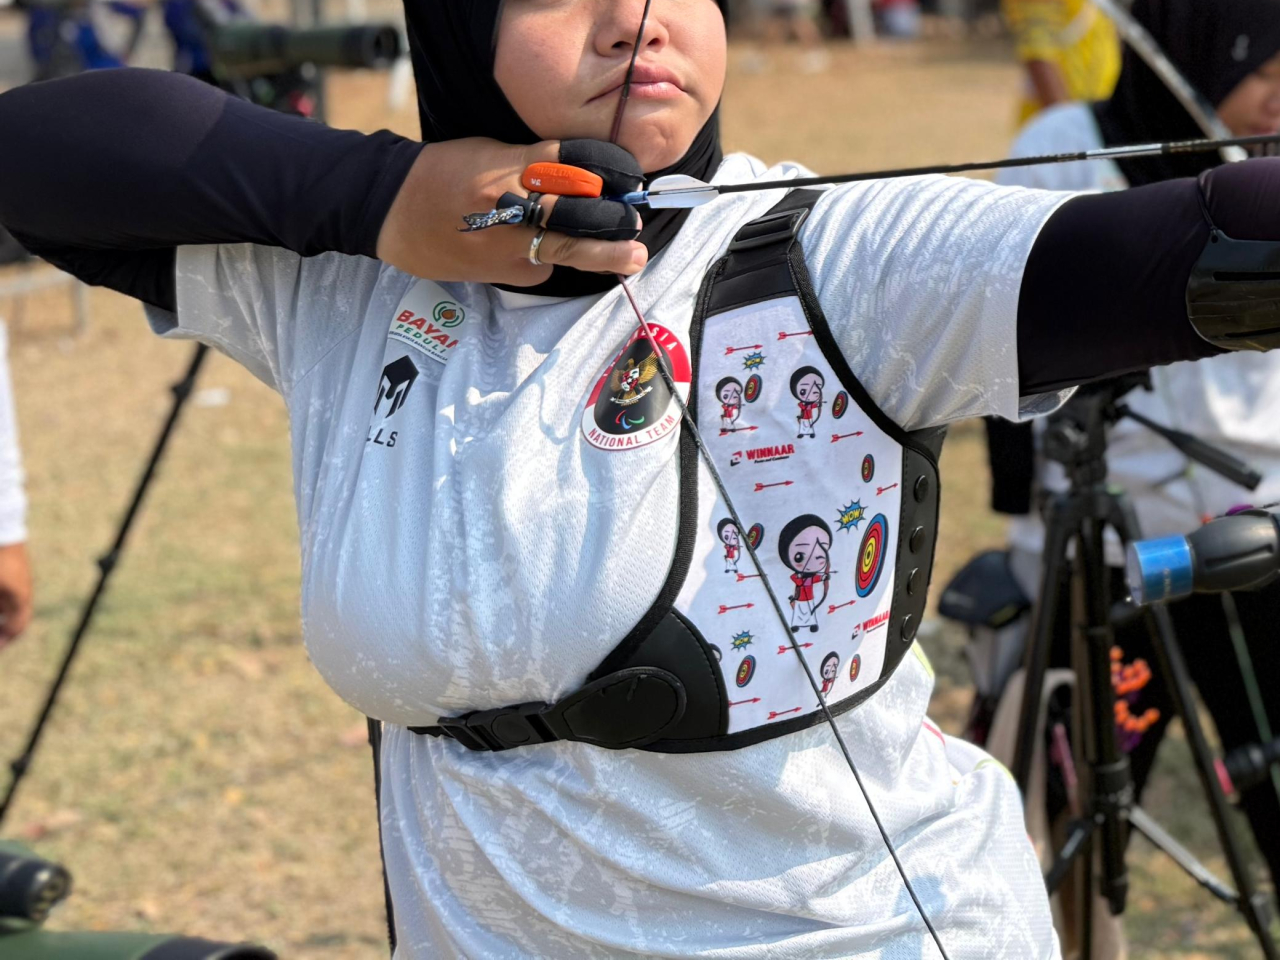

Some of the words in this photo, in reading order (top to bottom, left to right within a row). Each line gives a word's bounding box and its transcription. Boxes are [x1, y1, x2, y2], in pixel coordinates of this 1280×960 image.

[396, 323, 447, 354] PEDULI
[588, 427, 641, 448] NATIONAL
[646, 415, 675, 439] TEAM
[746, 444, 795, 460] WINNAAR
[842, 507, 864, 525] WOW!
